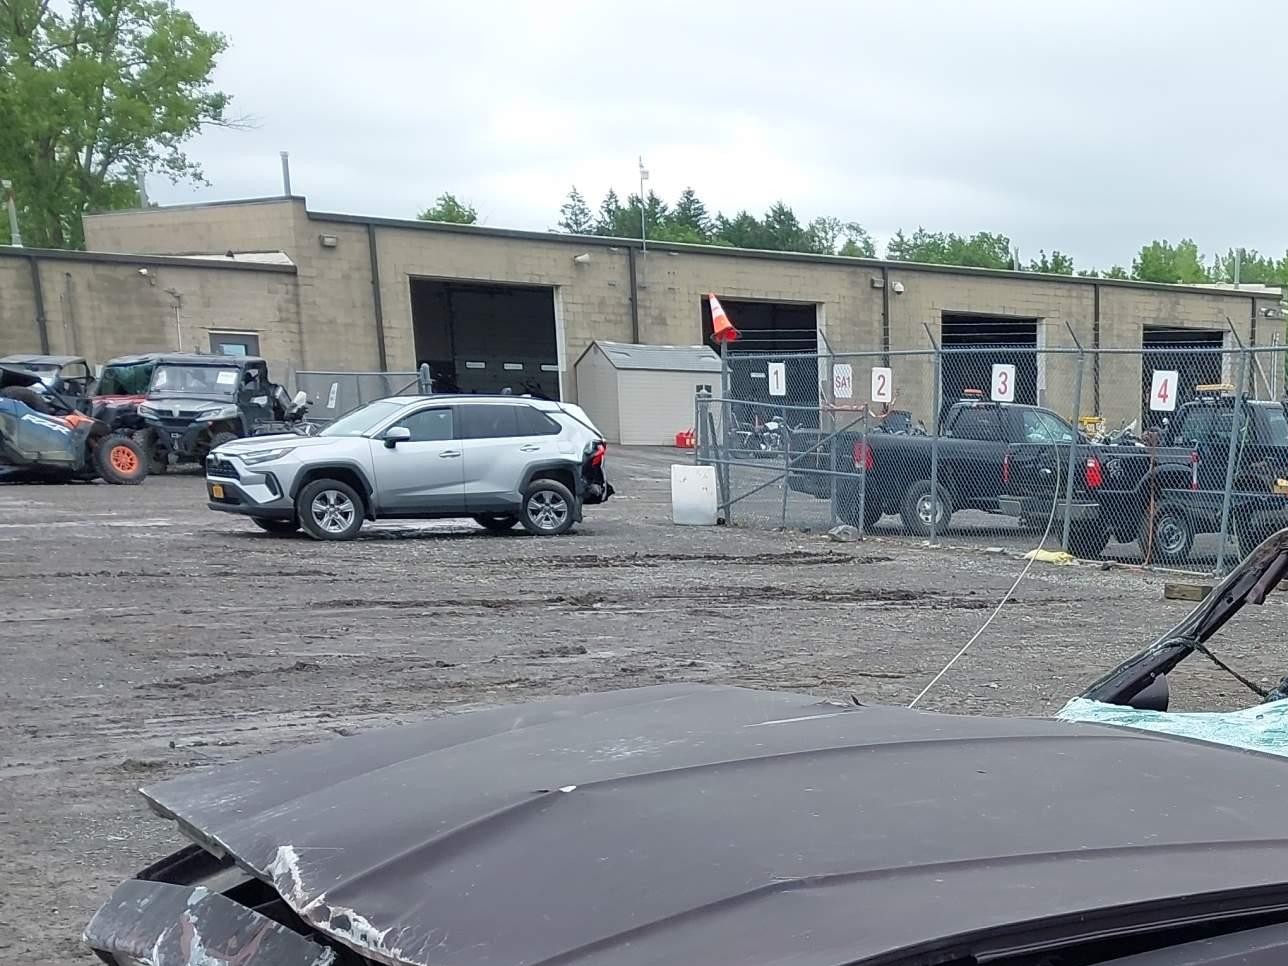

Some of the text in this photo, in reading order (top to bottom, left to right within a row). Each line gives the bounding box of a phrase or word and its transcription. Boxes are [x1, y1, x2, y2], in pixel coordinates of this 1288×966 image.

[773, 369, 779, 390] 1
[835, 376, 851, 389] SA1
[877, 374, 886, 396] 2
[997, 371, 1009, 395] 3
[1157, 380, 1169, 404] 4
